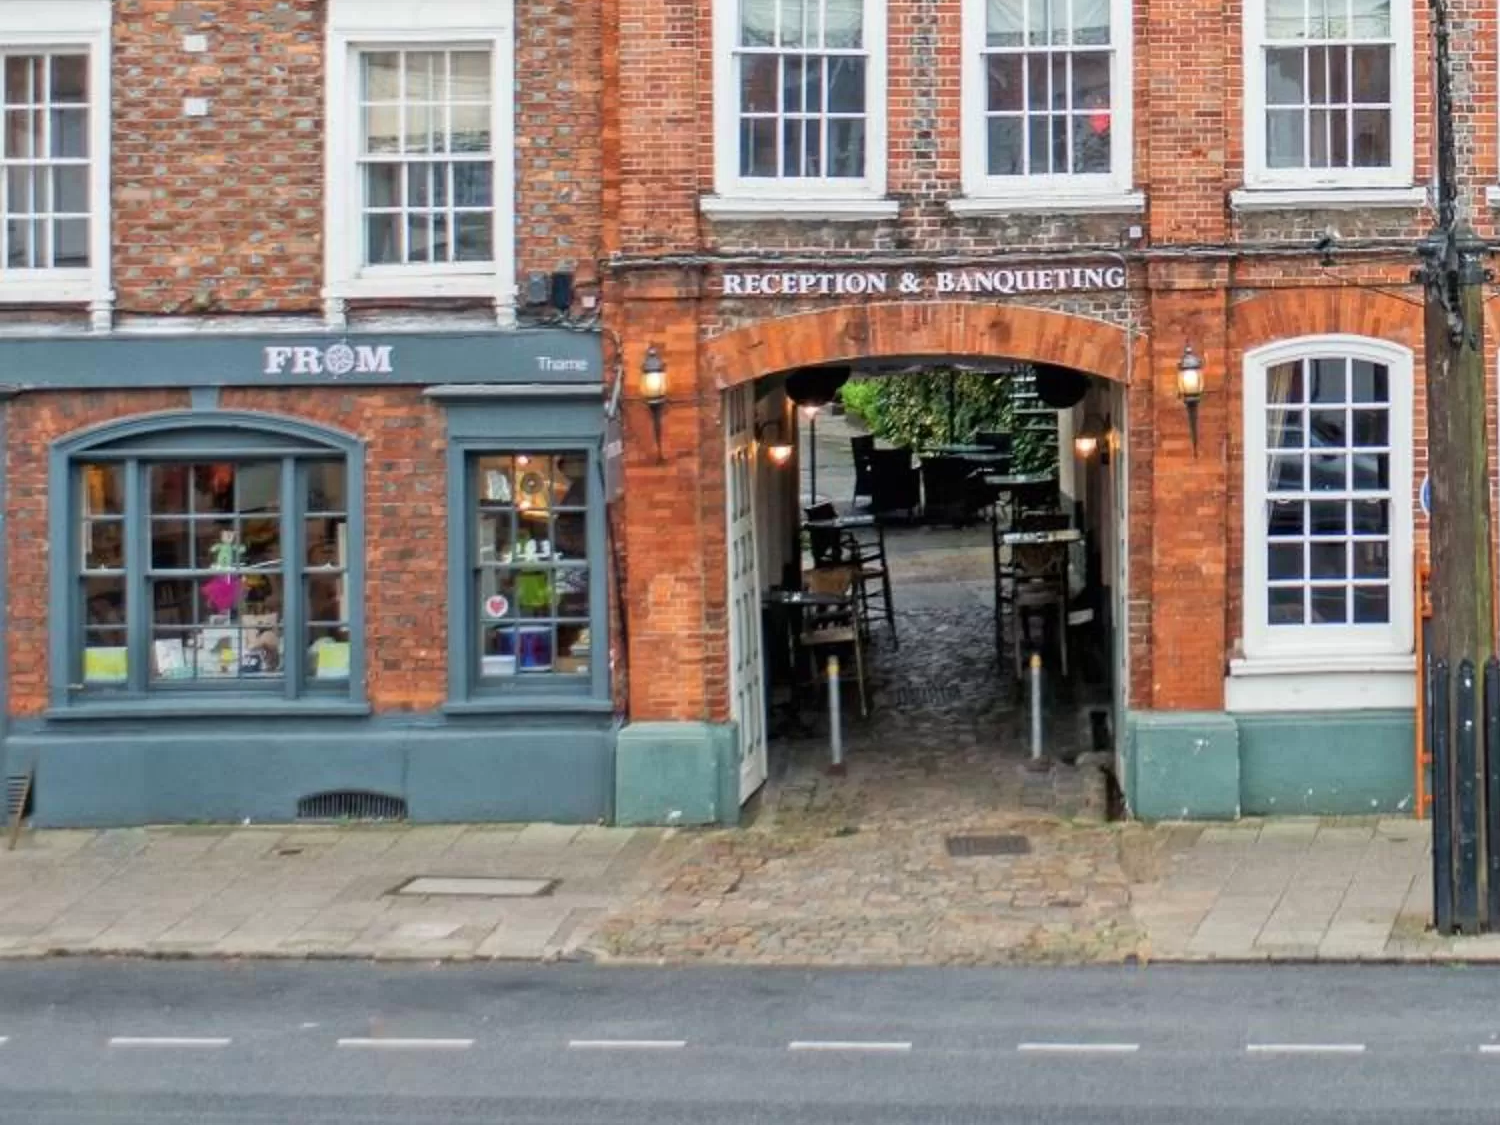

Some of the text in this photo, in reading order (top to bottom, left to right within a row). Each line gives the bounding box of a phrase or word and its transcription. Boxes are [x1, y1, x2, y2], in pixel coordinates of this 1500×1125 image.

[722, 266, 1126, 295] RECEPTION & BANQUETING
[264, 343, 394, 375] FROM
